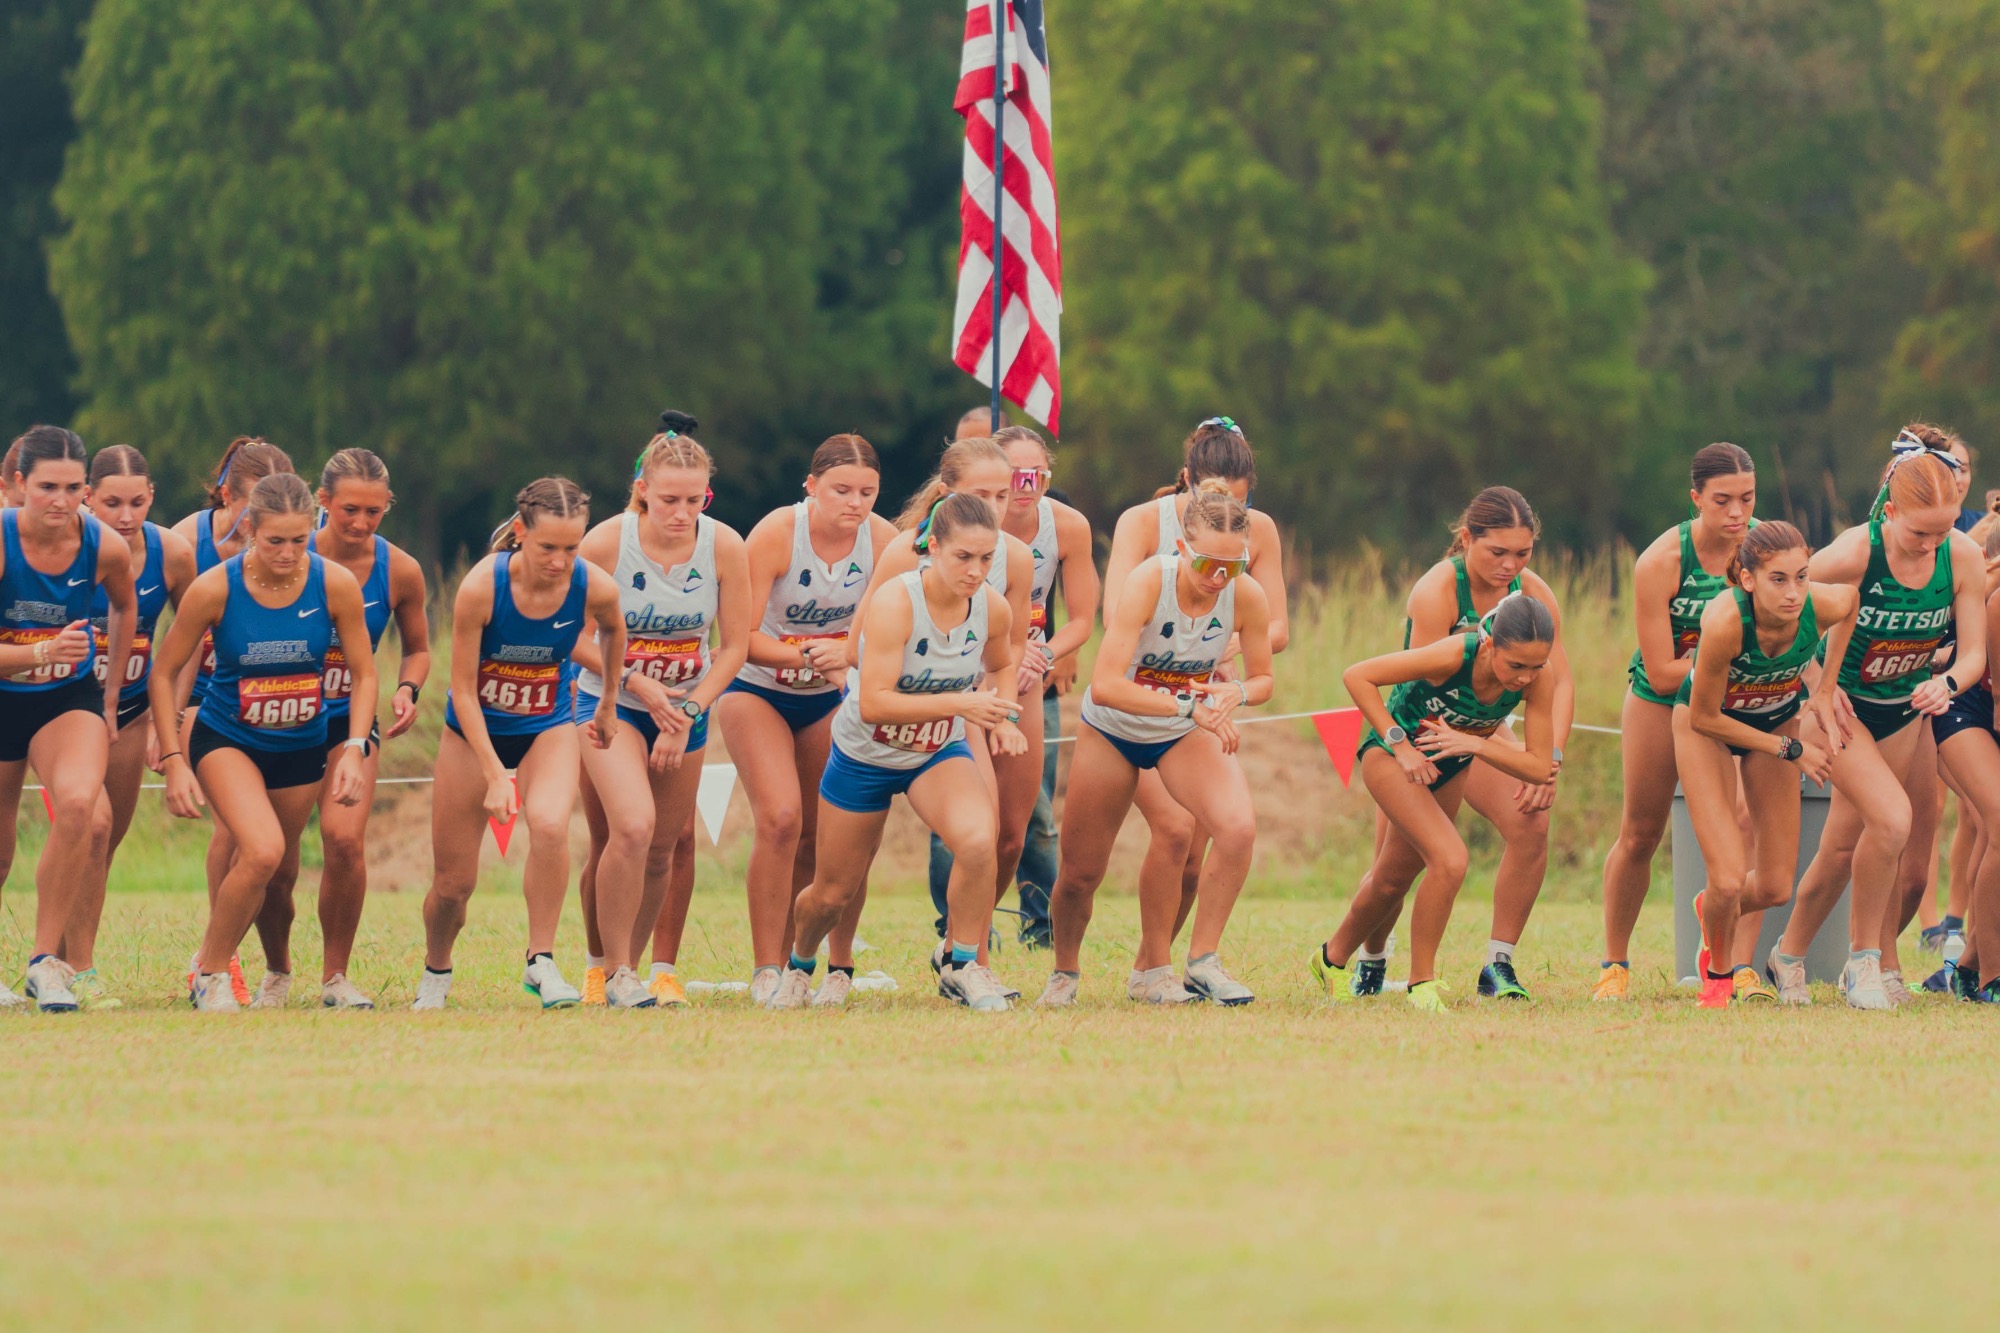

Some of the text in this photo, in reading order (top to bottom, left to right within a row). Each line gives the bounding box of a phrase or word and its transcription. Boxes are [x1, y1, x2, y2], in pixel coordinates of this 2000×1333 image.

[624, 603, 704, 635] Argos
[785, 599, 856, 627] Argos
[247, 640, 309, 655] NORTH
[628, 658, 695, 682] 4641
[1142, 651, 1217, 673] Argos
[1865, 652, 1931, 678] 4660
[480, 679, 550, 707] 4611
[896, 667, 975, 694] Argos
[243, 697, 317, 724] 4605
[880, 719, 950, 746] 4640
